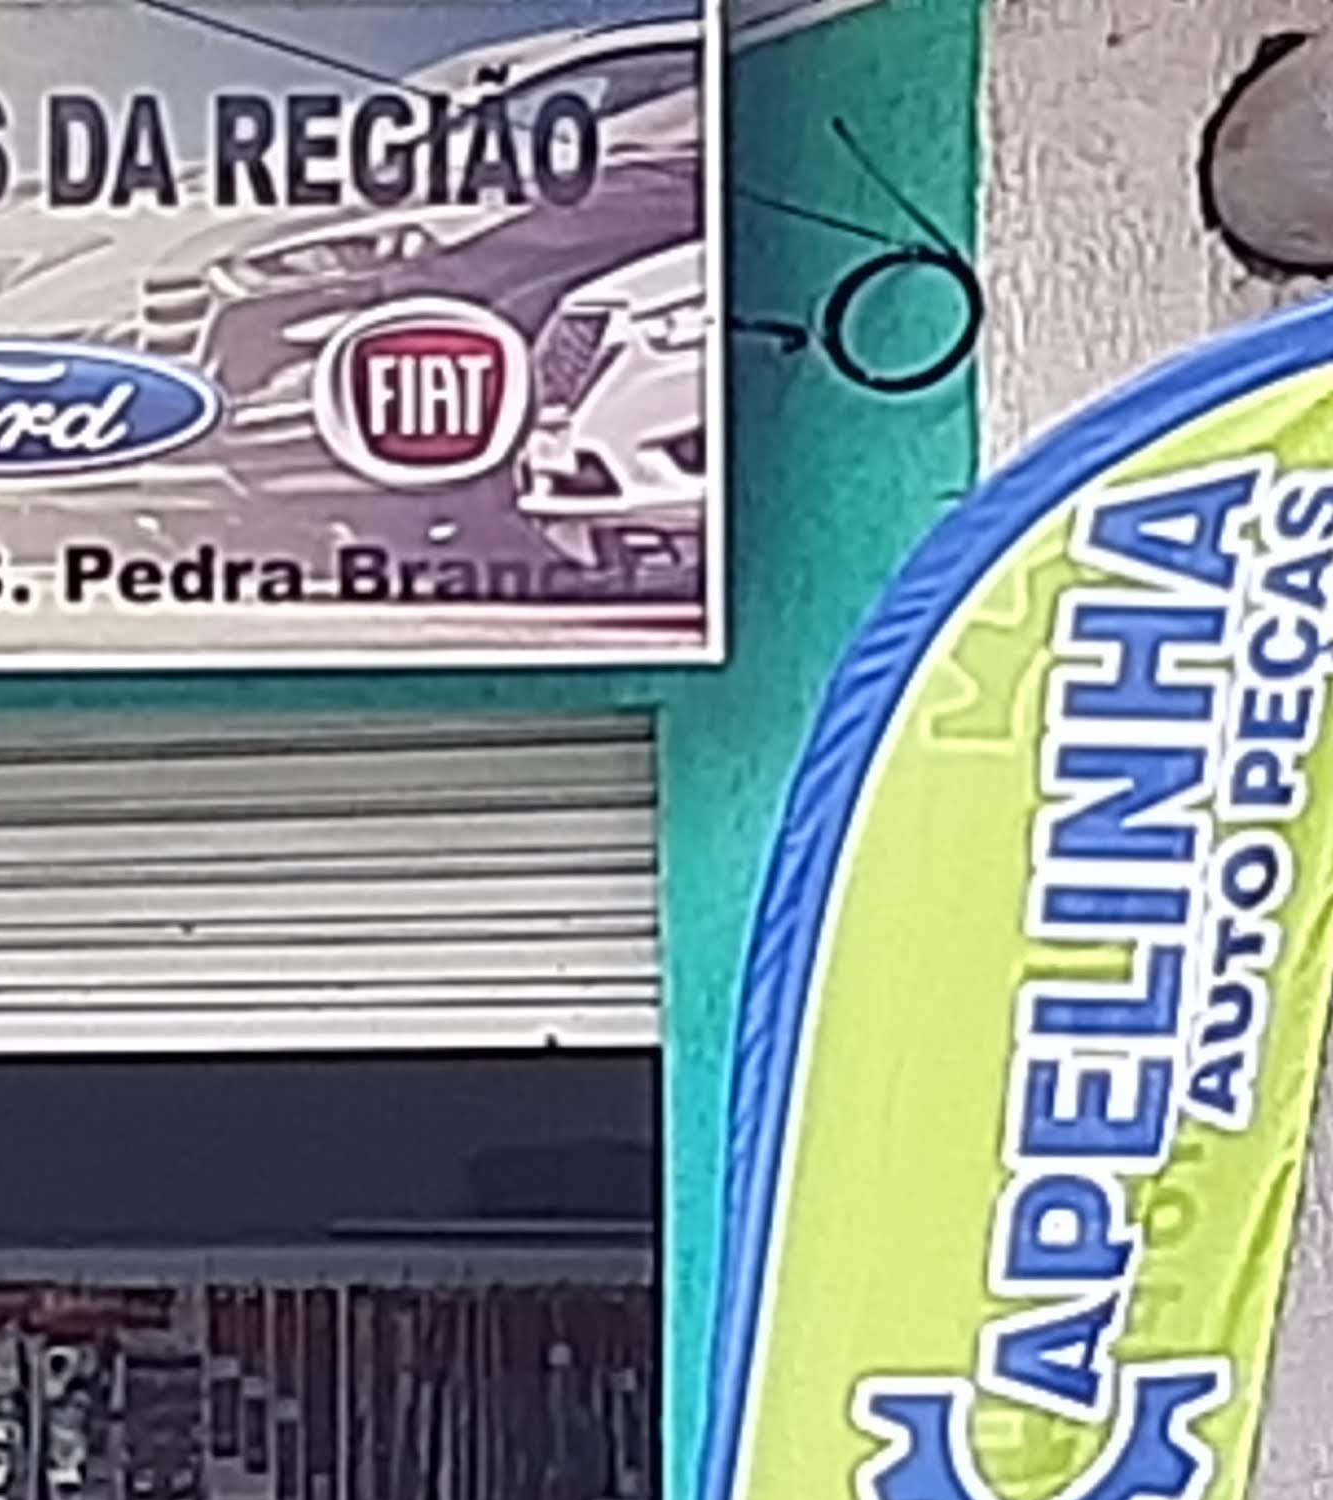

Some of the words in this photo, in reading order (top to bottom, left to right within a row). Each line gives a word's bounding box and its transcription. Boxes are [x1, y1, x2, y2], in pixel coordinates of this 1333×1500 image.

[48, 94, 178, 209] DA
[216, 66, 601, 208] REGIÃO
[365, 352, 492, 439] FIAT
[67, 545, 303, 603] Pedra
[1230, 485, 1333, 805] PEÇAS
[1190, 843, 1279, 1115] AUTO
